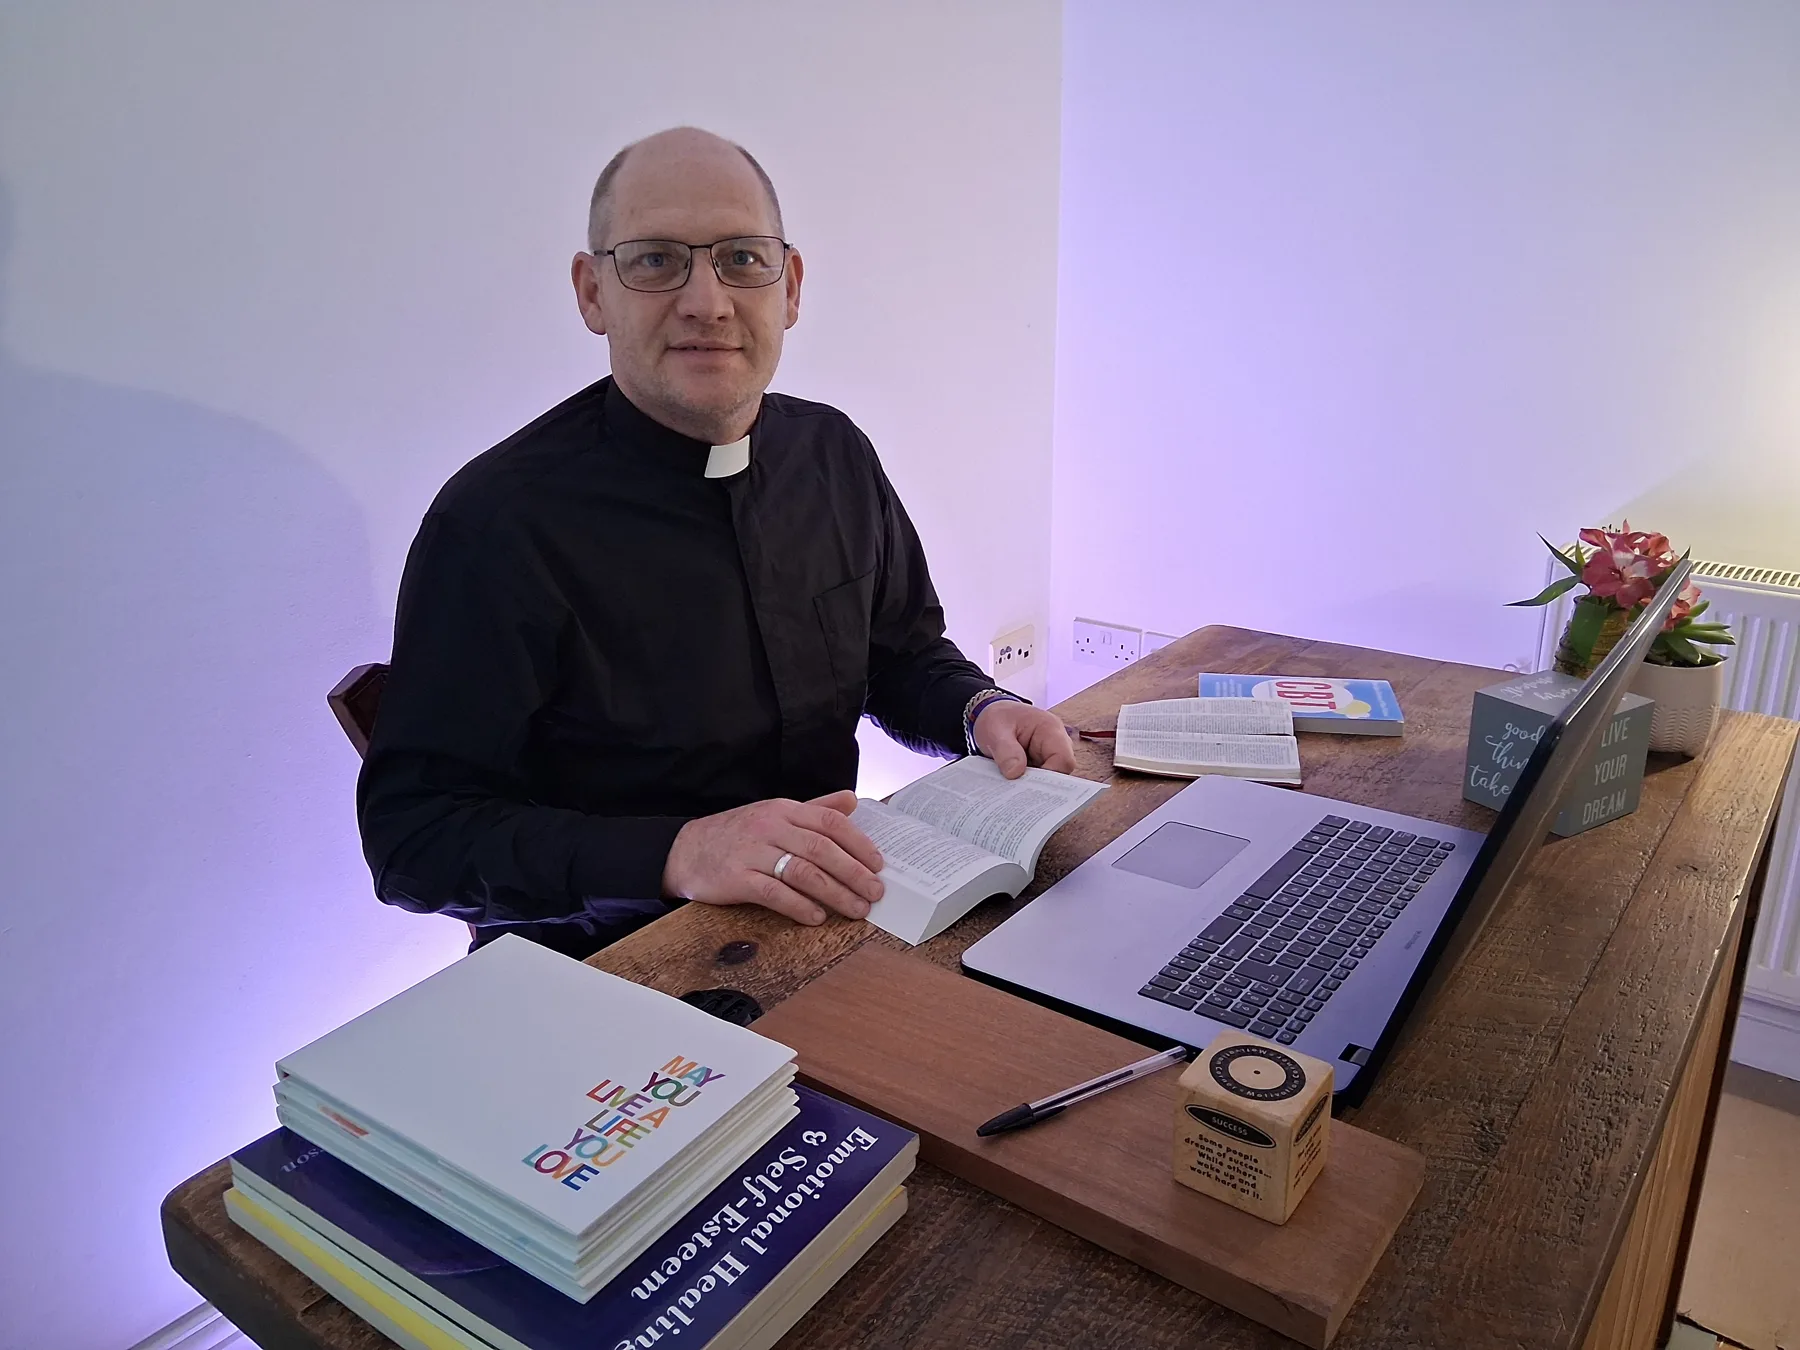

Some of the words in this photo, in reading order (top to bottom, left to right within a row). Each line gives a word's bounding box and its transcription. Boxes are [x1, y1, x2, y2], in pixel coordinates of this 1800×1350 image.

[1275, 681, 1336, 710] CBT
[1502, 722, 1546, 744] good
[1601, 717, 1631, 748] LIVE
[1484, 735, 1530, 769] thin
[1469, 765, 1511, 797] take
[1594, 754, 1628, 786] YOUR
[1582, 788, 1627, 826] DREAM
[660, 1055, 726, 1088] MAY
[586, 1079, 653, 1117] LIVE
[637, 1106, 671, 1129] A
[641, 1071, 702, 1107] YOU
[584, 1109, 652, 1148] LIFE
[802, 1130, 827, 1146] &
[1211, 1116, 1248, 1136] SUCCESS
[564, 1128, 627, 1167] YOU
[1184, 1137, 1214, 1154] dream
[1216, 1151, 1226, 1159] of
[1198, 1134, 1223, 1149] Some
[1226, 1146, 1259, 1163] people
[521, 1144, 600, 1191] LOVE
[1189, 1165, 1212, 1179] work
[1215, 1175, 1237, 1190] hard
[1240, 1187, 1250, 1196] at
[1196, 1160, 1220, 1174] wake
[1223, 1171, 1235, 1181] up
[1238, 1177, 1257, 1190] and
[1197, 1150, 1223, 1166] While
[1227, 1164, 1257, 1181] others
[741, 1126, 879, 1255] Emotional
[631, 1147, 807, 1301] Self-Esteem
